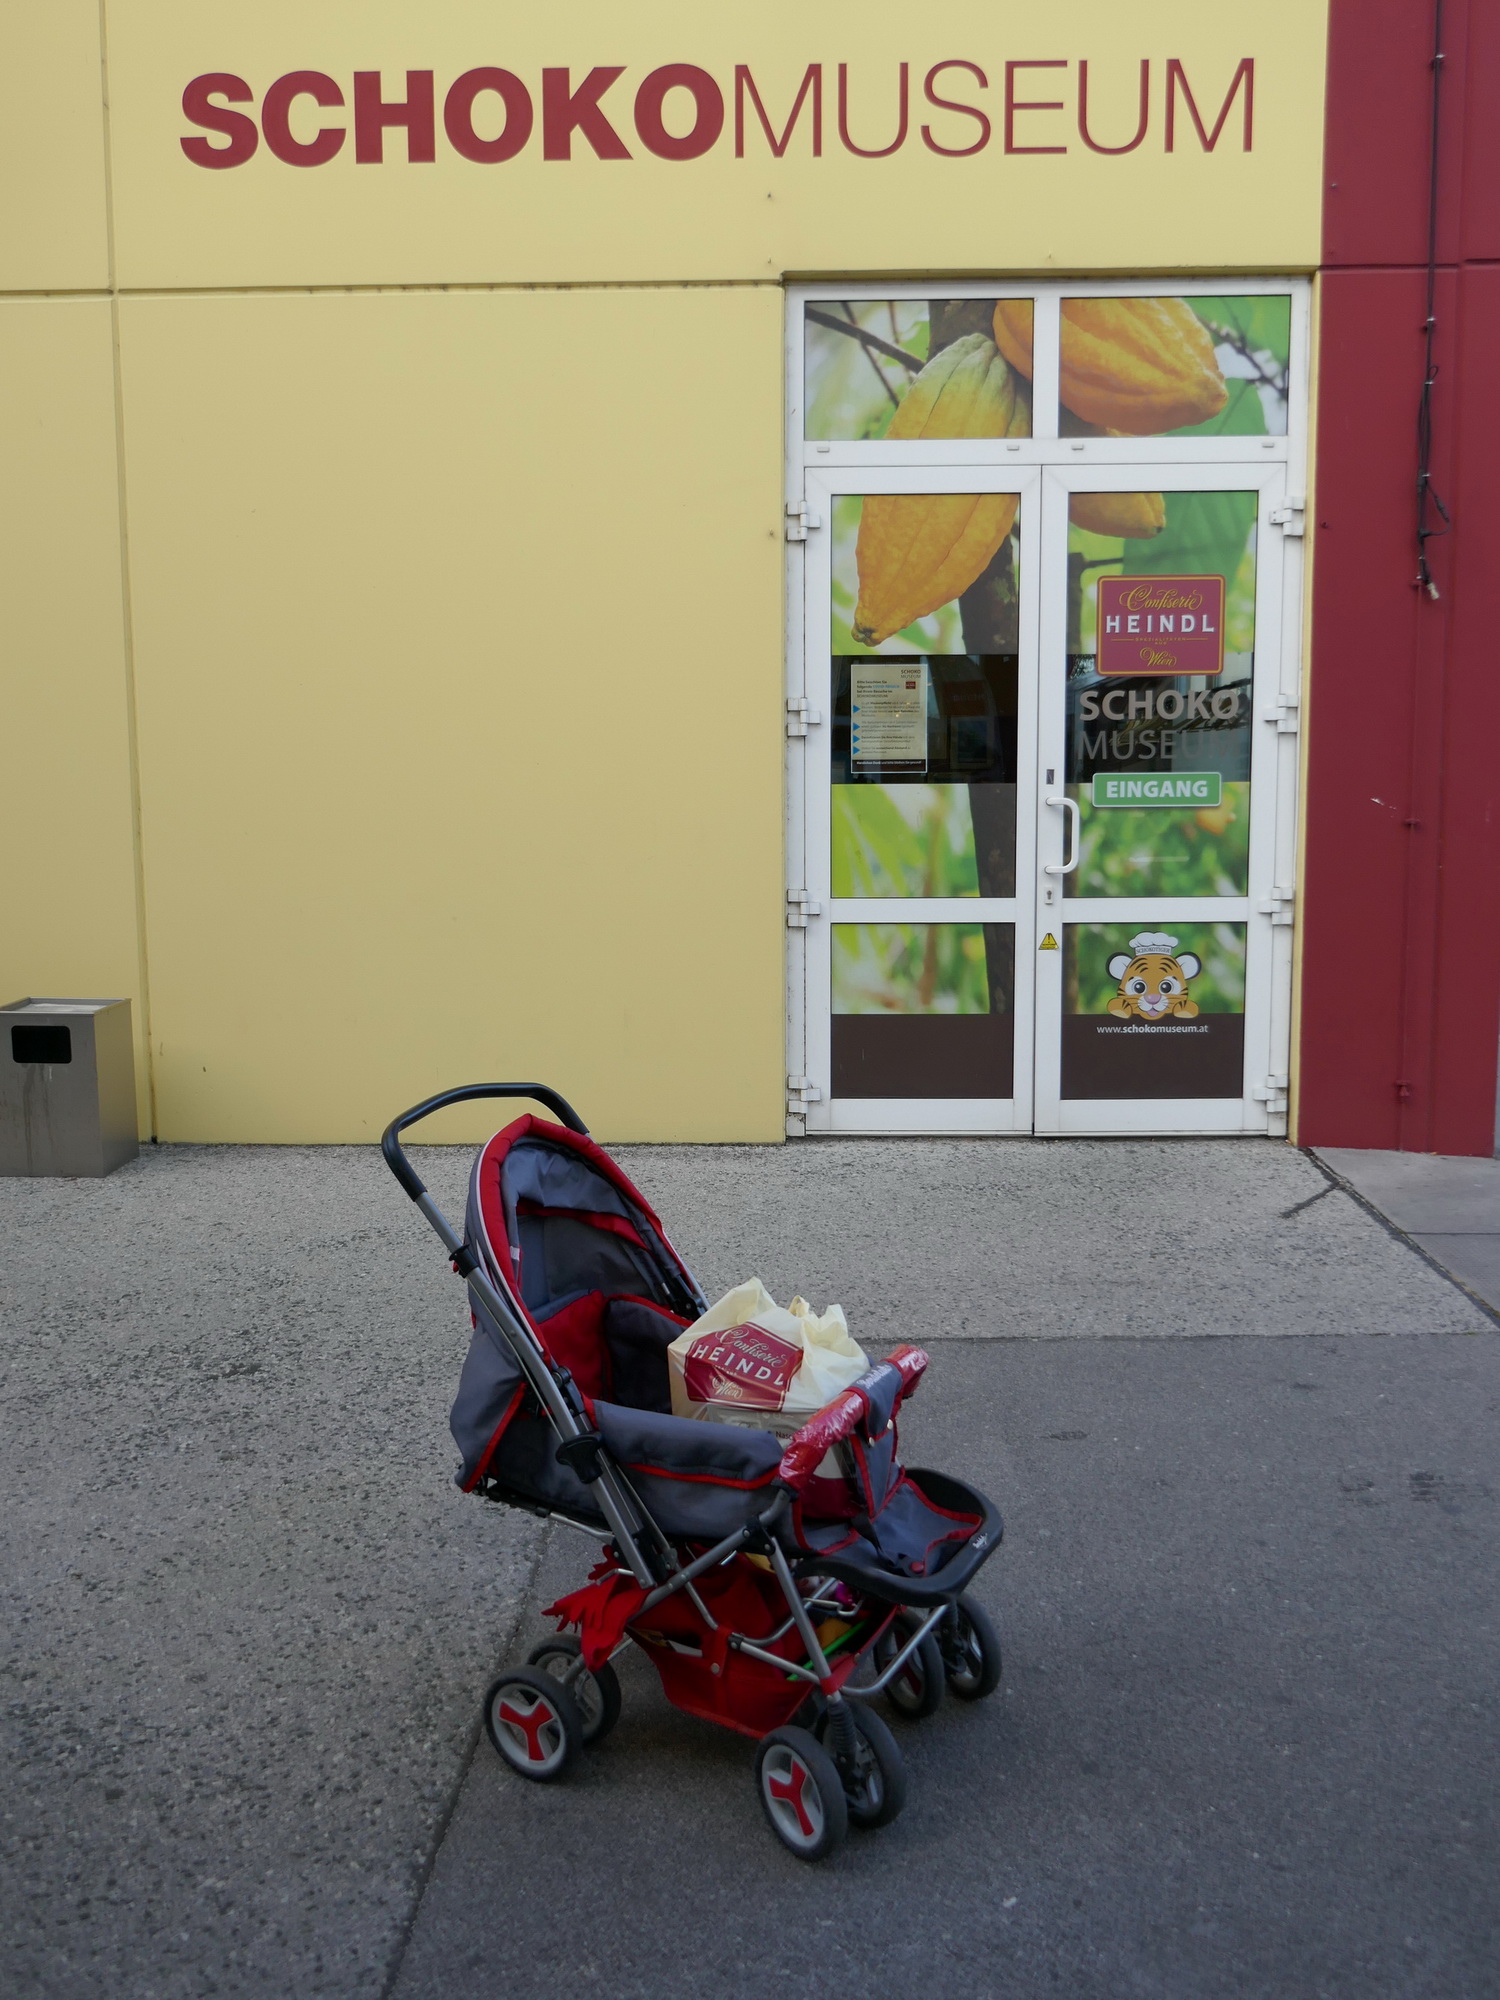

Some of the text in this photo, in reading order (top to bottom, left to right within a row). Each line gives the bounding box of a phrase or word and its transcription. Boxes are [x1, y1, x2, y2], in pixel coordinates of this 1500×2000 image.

[1119, 584, 1203, 611] Confiserie
[1105, 614, 1215, 634] HEINDL
[1139, 646, 1177, 667] Wien
[1079, 689, 1240, 721] SCHOKO
[1106, 780, 1209, 798] EINGANG
[1097, 1023, 1209, 1034] www.schokomuseum.at
[715, 1327, 788, 1368] Confiserie
[691, 1344, 785, 1386] HEINDL
